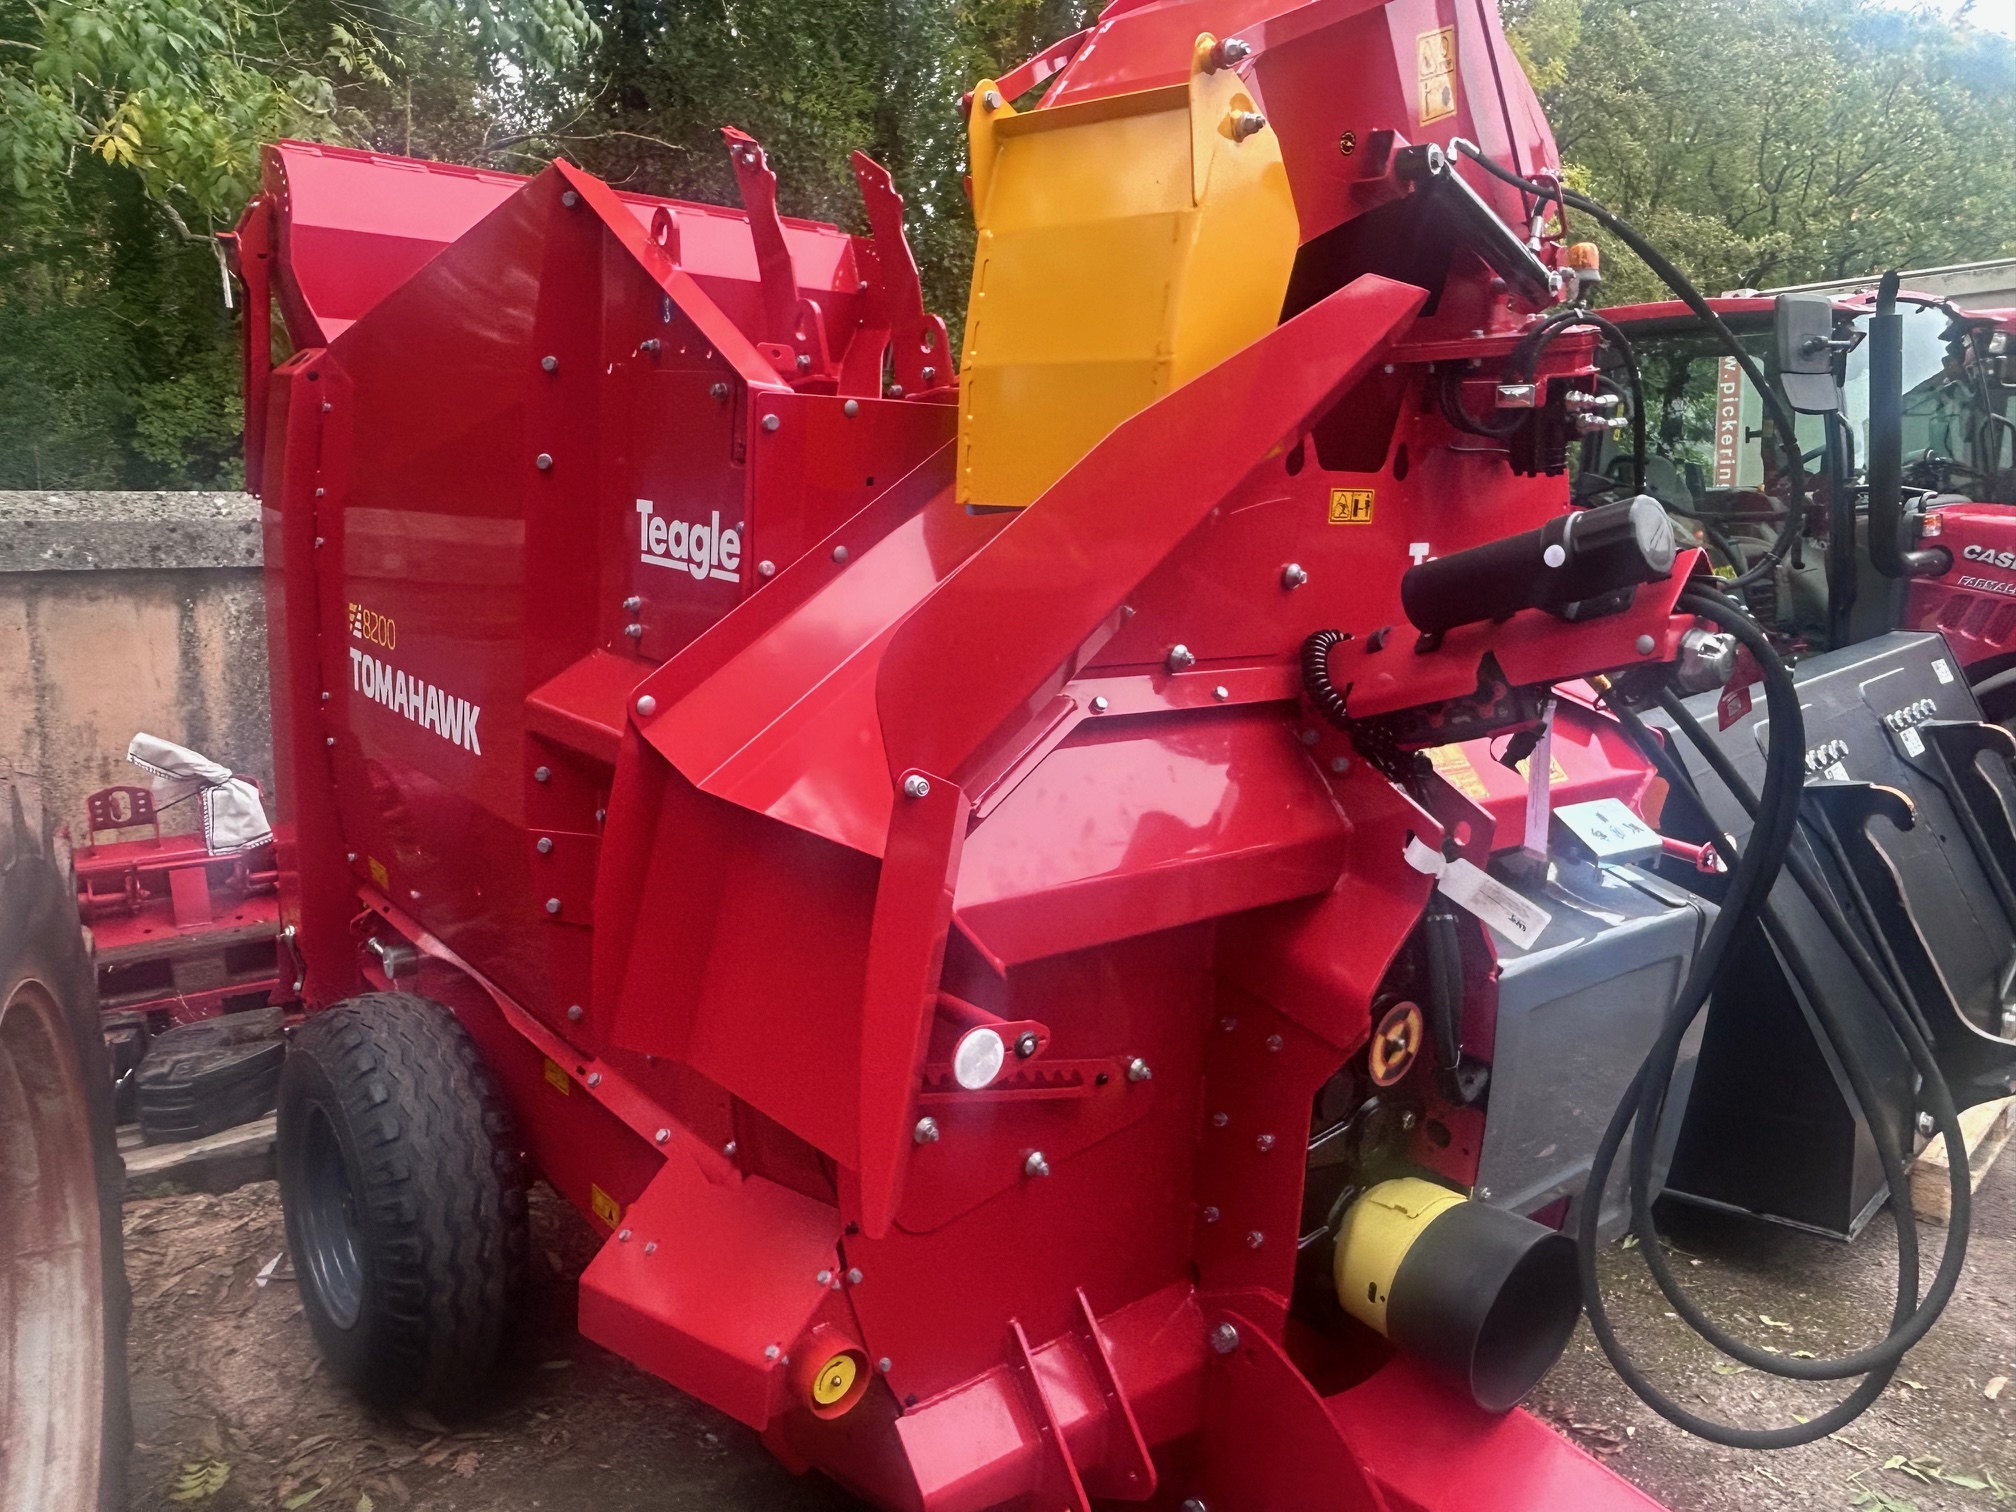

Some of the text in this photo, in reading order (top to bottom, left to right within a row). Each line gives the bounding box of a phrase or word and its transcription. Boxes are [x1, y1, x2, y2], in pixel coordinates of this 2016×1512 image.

[1716, 355, 1739, 487] w.pickerin
[636, 499, 741, 581] Teagle
[362, 609, 396, 650] 8200
[350, 647, 482, 756] TOMAHAWK
